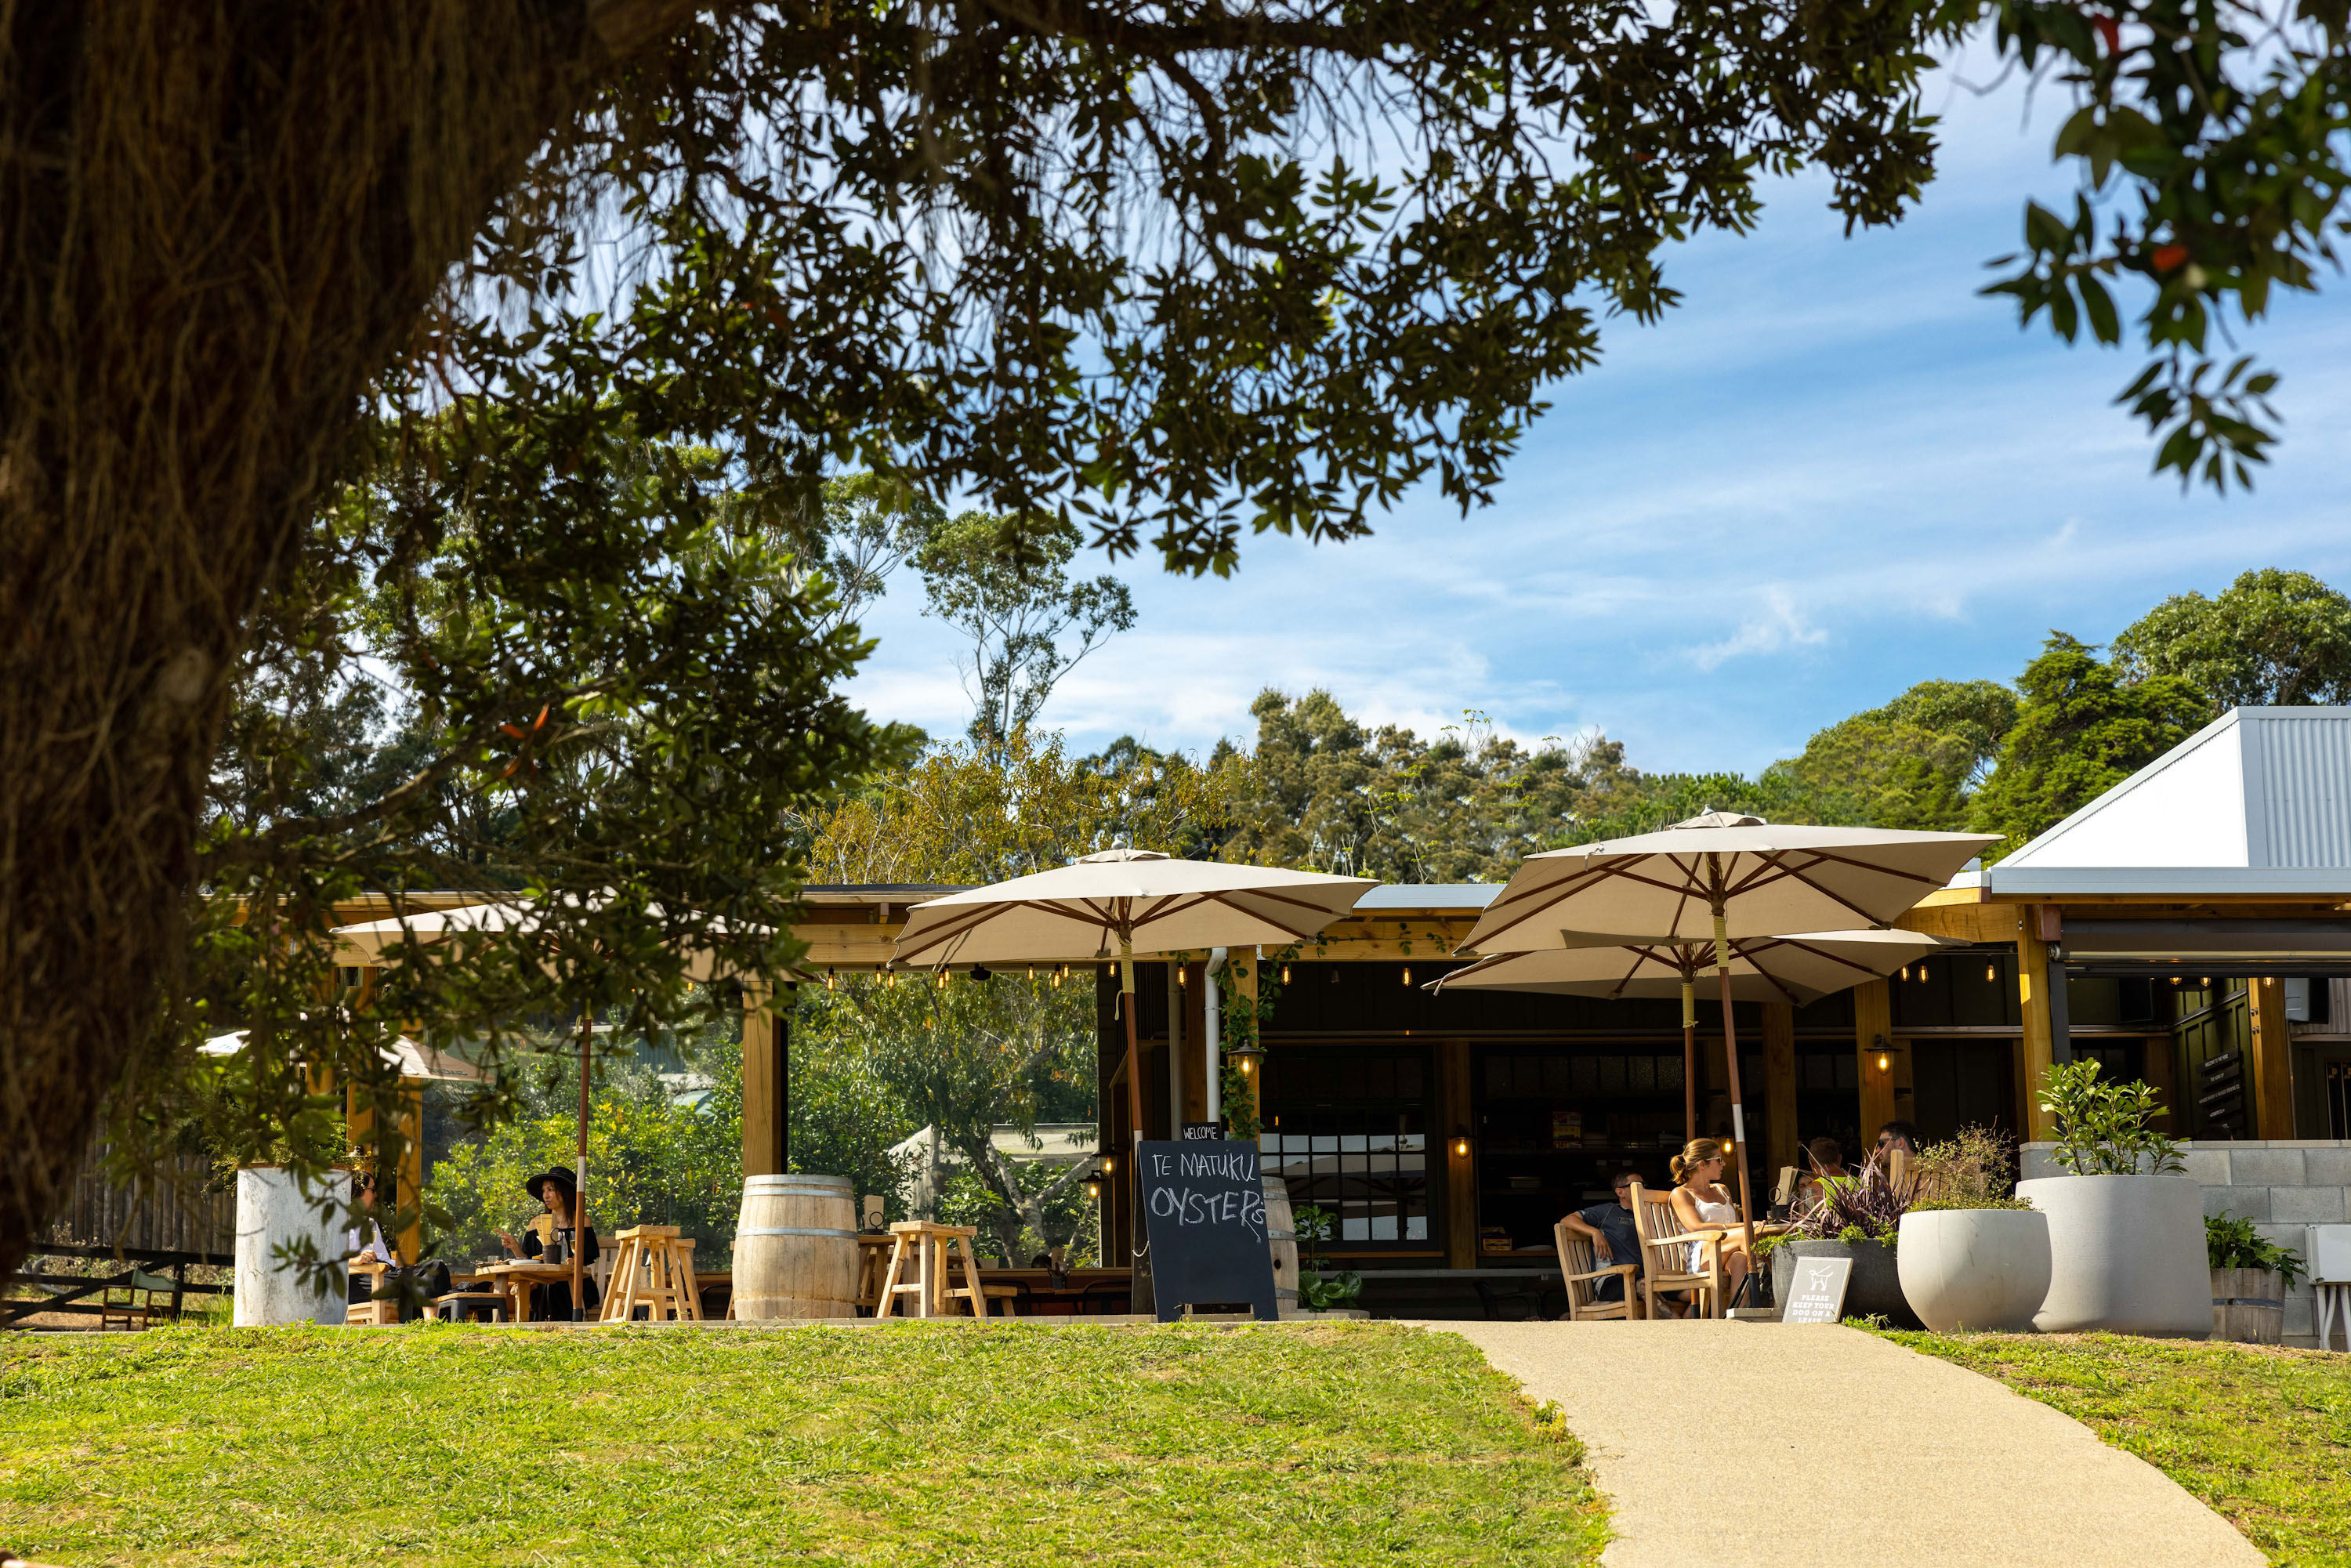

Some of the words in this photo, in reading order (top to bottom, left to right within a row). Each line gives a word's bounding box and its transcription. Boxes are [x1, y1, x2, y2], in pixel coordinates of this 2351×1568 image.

[1183, 1126, 1218, 1140] WELCOME
[1152, 1154, 1172, 1177] TE
[1181, 1153, 1256, 1182] MATUKU
[1150, 1186, 1266, 1244] OYSTERS
